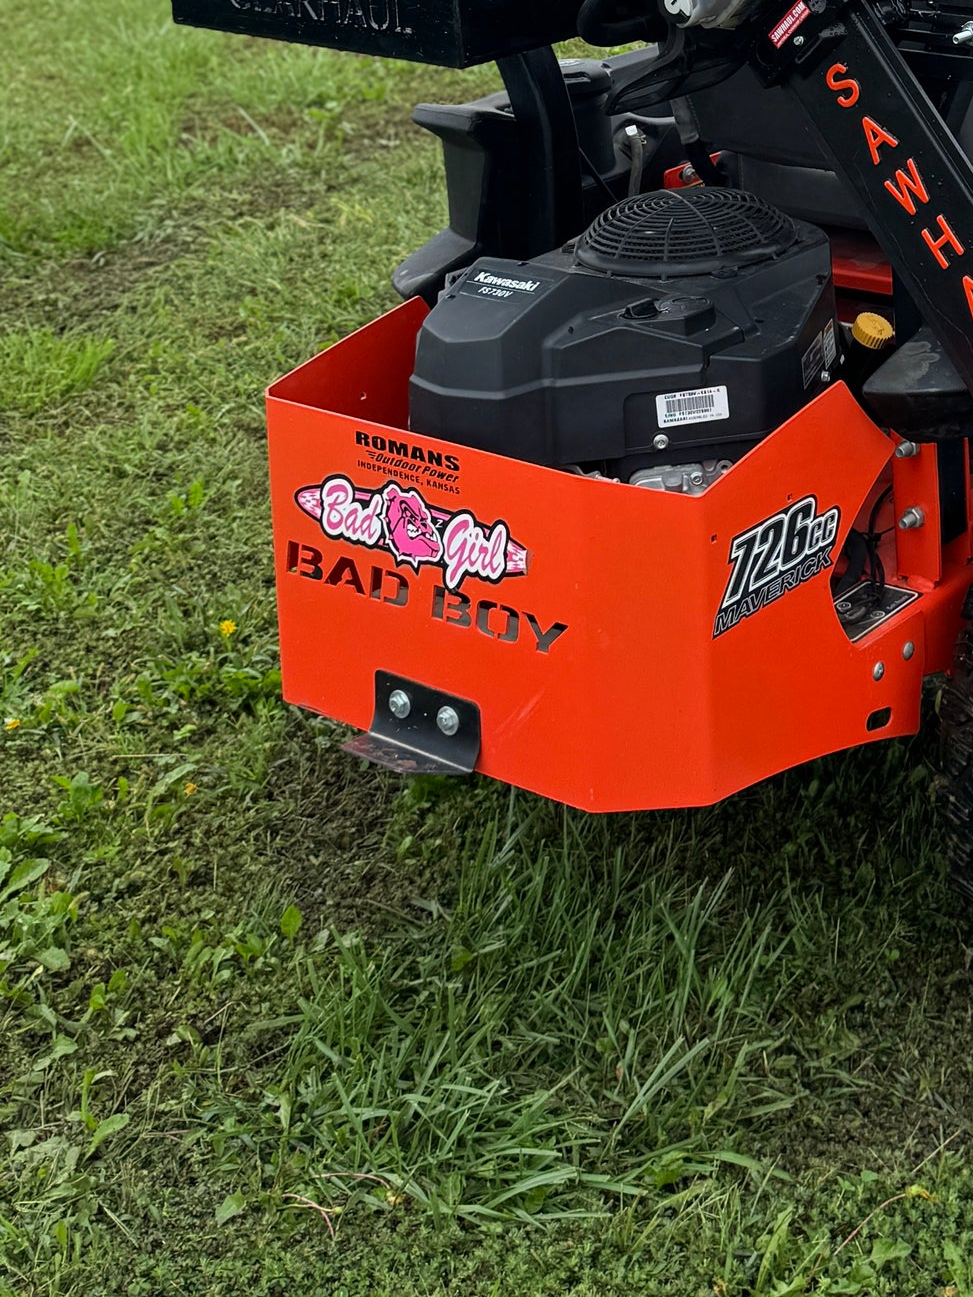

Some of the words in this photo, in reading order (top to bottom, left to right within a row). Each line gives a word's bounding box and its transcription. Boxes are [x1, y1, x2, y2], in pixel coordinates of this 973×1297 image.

[771, 1, 807, 42] SAWHAUL.COM
[473, 271, 541, 292] Kawasaki
[477, 286, 514, 298] FS730V
[355, 430, 460, 472] ROMANS
[375, 453, 422, 473] Outdoor
[421, 465, 460, 483] Power
[357, 460, 424, 486] INDEPENDENCE,
[426, 479, 460, 495] KANSAS
[323, 480, 382, 544] Bad
[445, 515, 506, 588] Girl
[288, 540, 410, 608] BAD
[431, 584, 569, 654] BOY
[713, 546, 833, 636] MAVERICK
